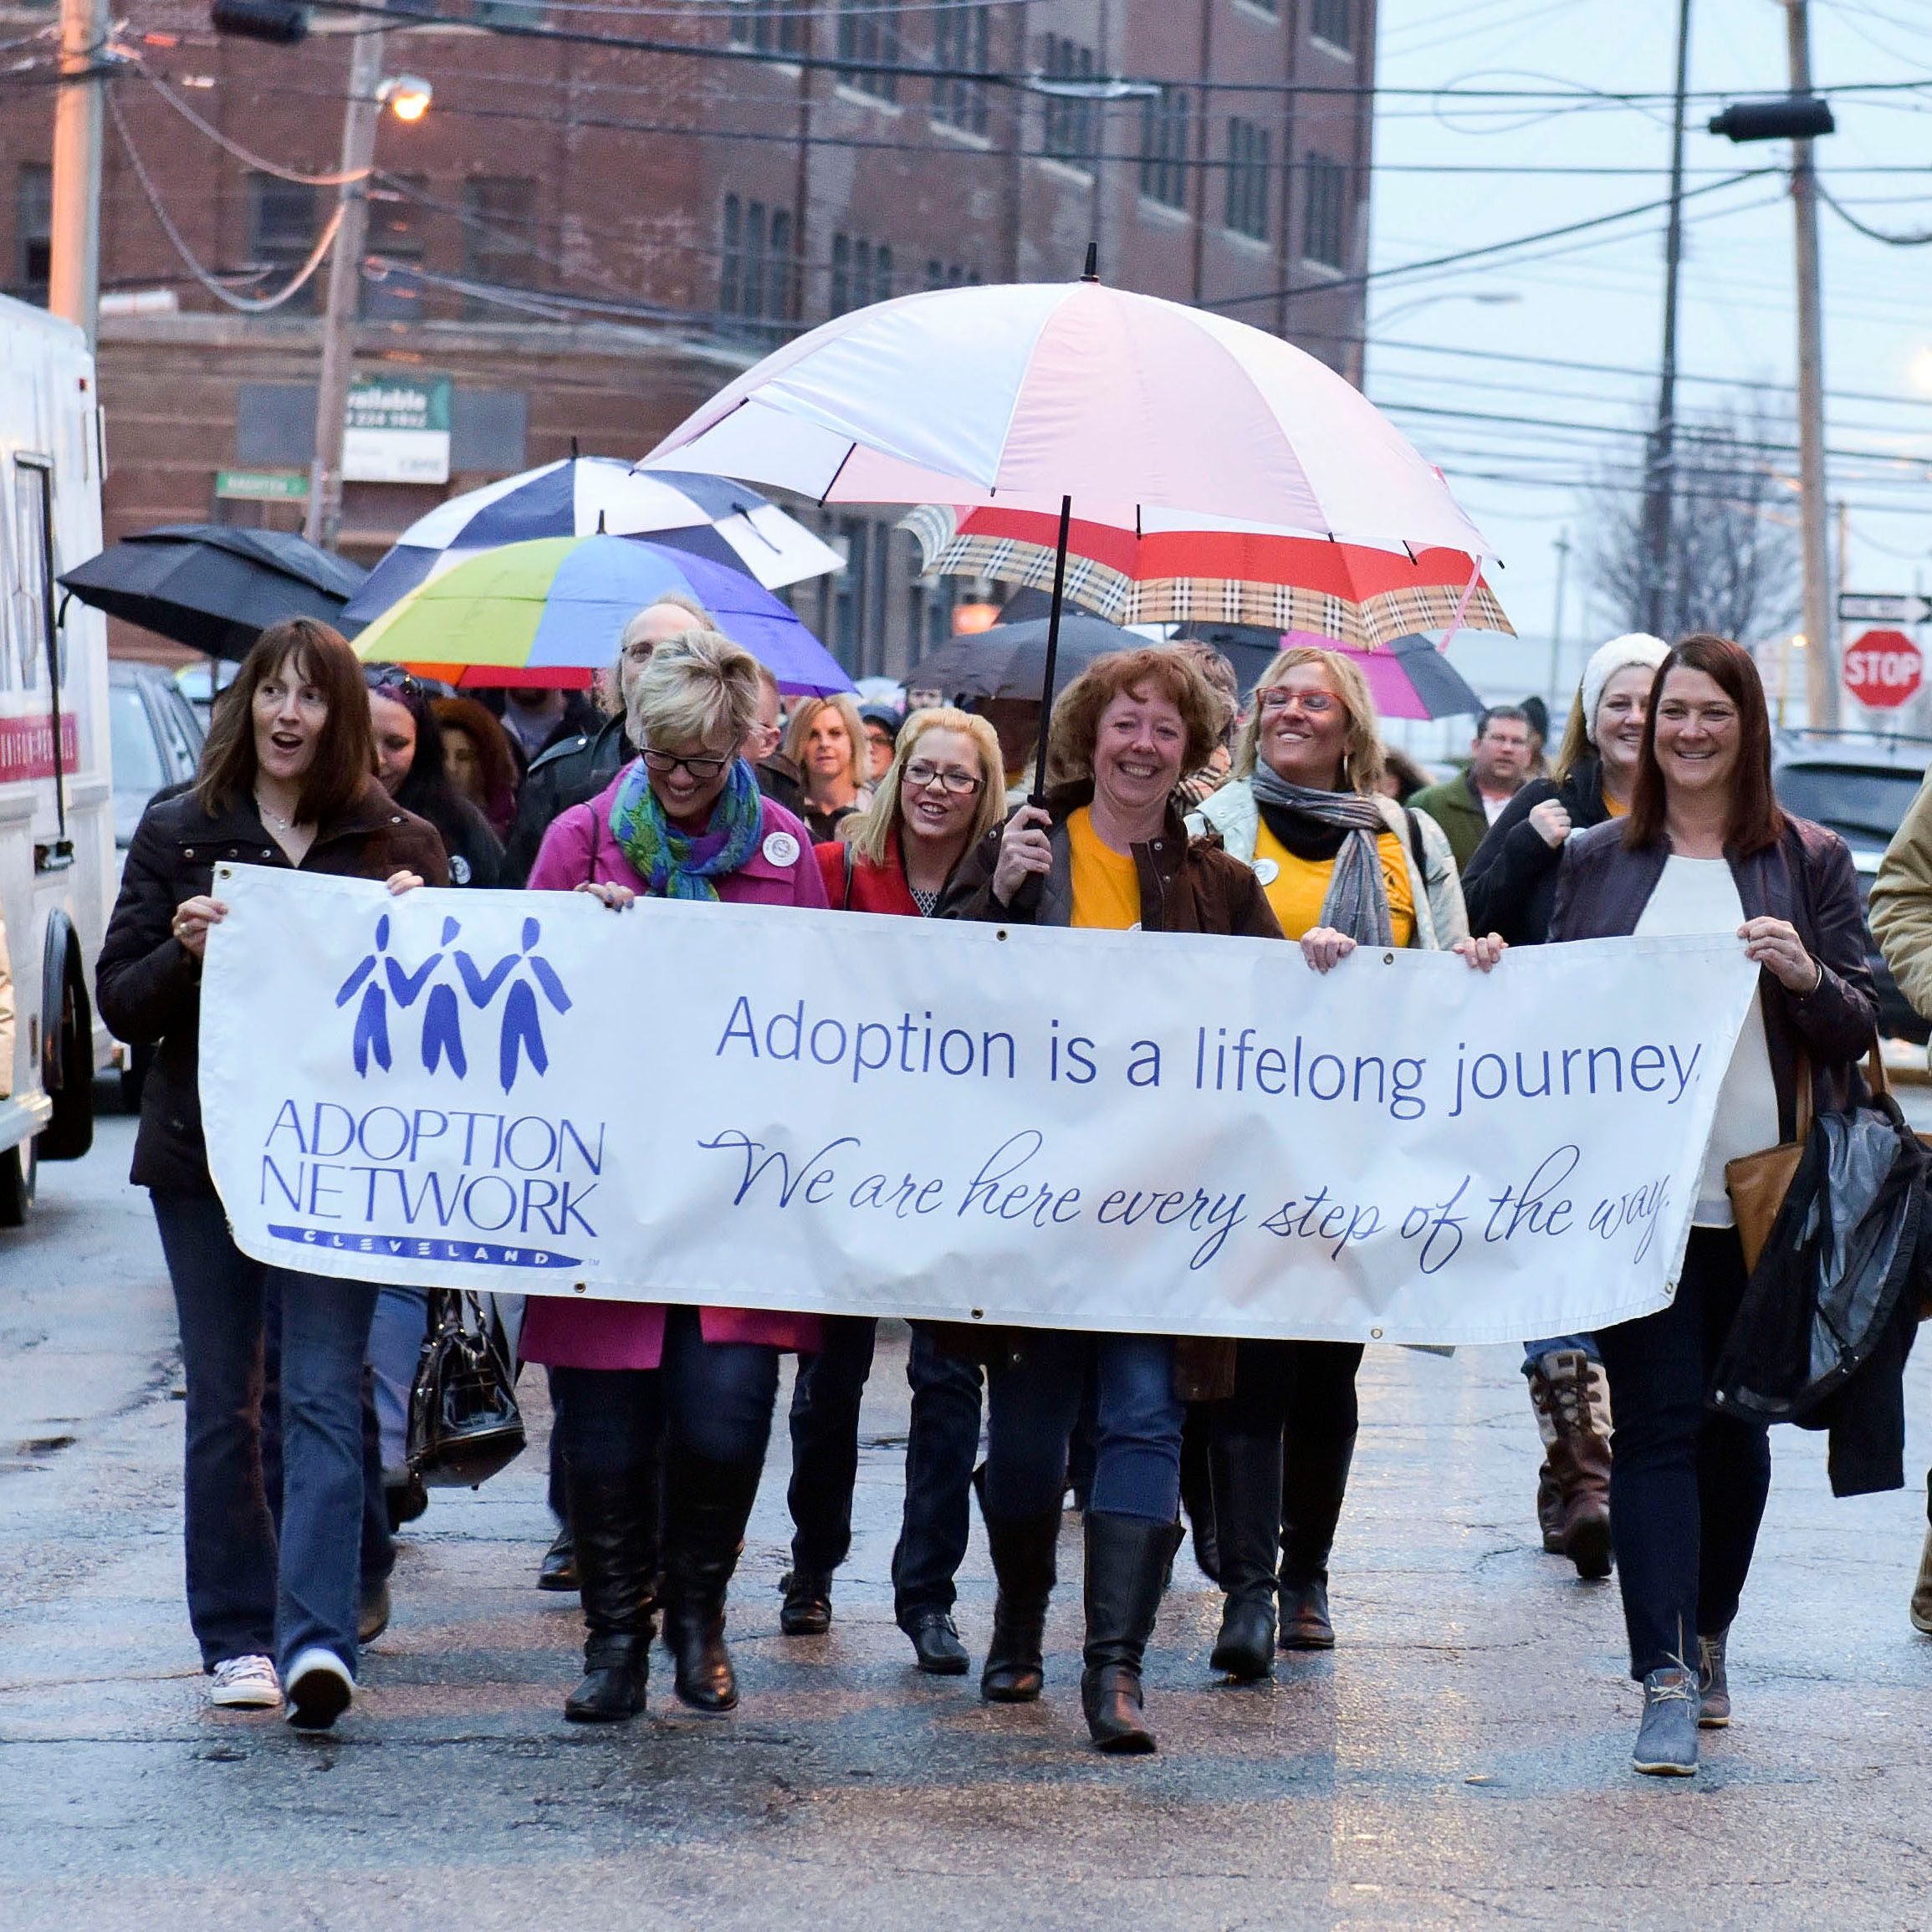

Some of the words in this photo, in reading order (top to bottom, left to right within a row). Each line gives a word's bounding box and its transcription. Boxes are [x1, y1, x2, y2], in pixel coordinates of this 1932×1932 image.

[1844, 651, 1922, 687] STOP
[716, 996, 1015, 1083] Adoption
[1051, 1020, 1096, 1084] is
[1127, 1040, 1160, 1086] a
[1196, 1025, 1427, 1120] lifelong
[265, 1099, 606, 1176] ADOPTION
[260, 1154, 600, 1238] NETWORK
[698, 1129, 861, 1209] We
[850, 1173, 943, 1219] are
[958, 1130, 1081, 1228] here
[1098, 1188, 1247, 1270] every
[1258, 1185, 1388, 1262] step
[1401, 1174, 1471, 1275] of
[1485, 1144, 1580, 1242] the
[303, 1230, 549, 1265] CLEVELAND
